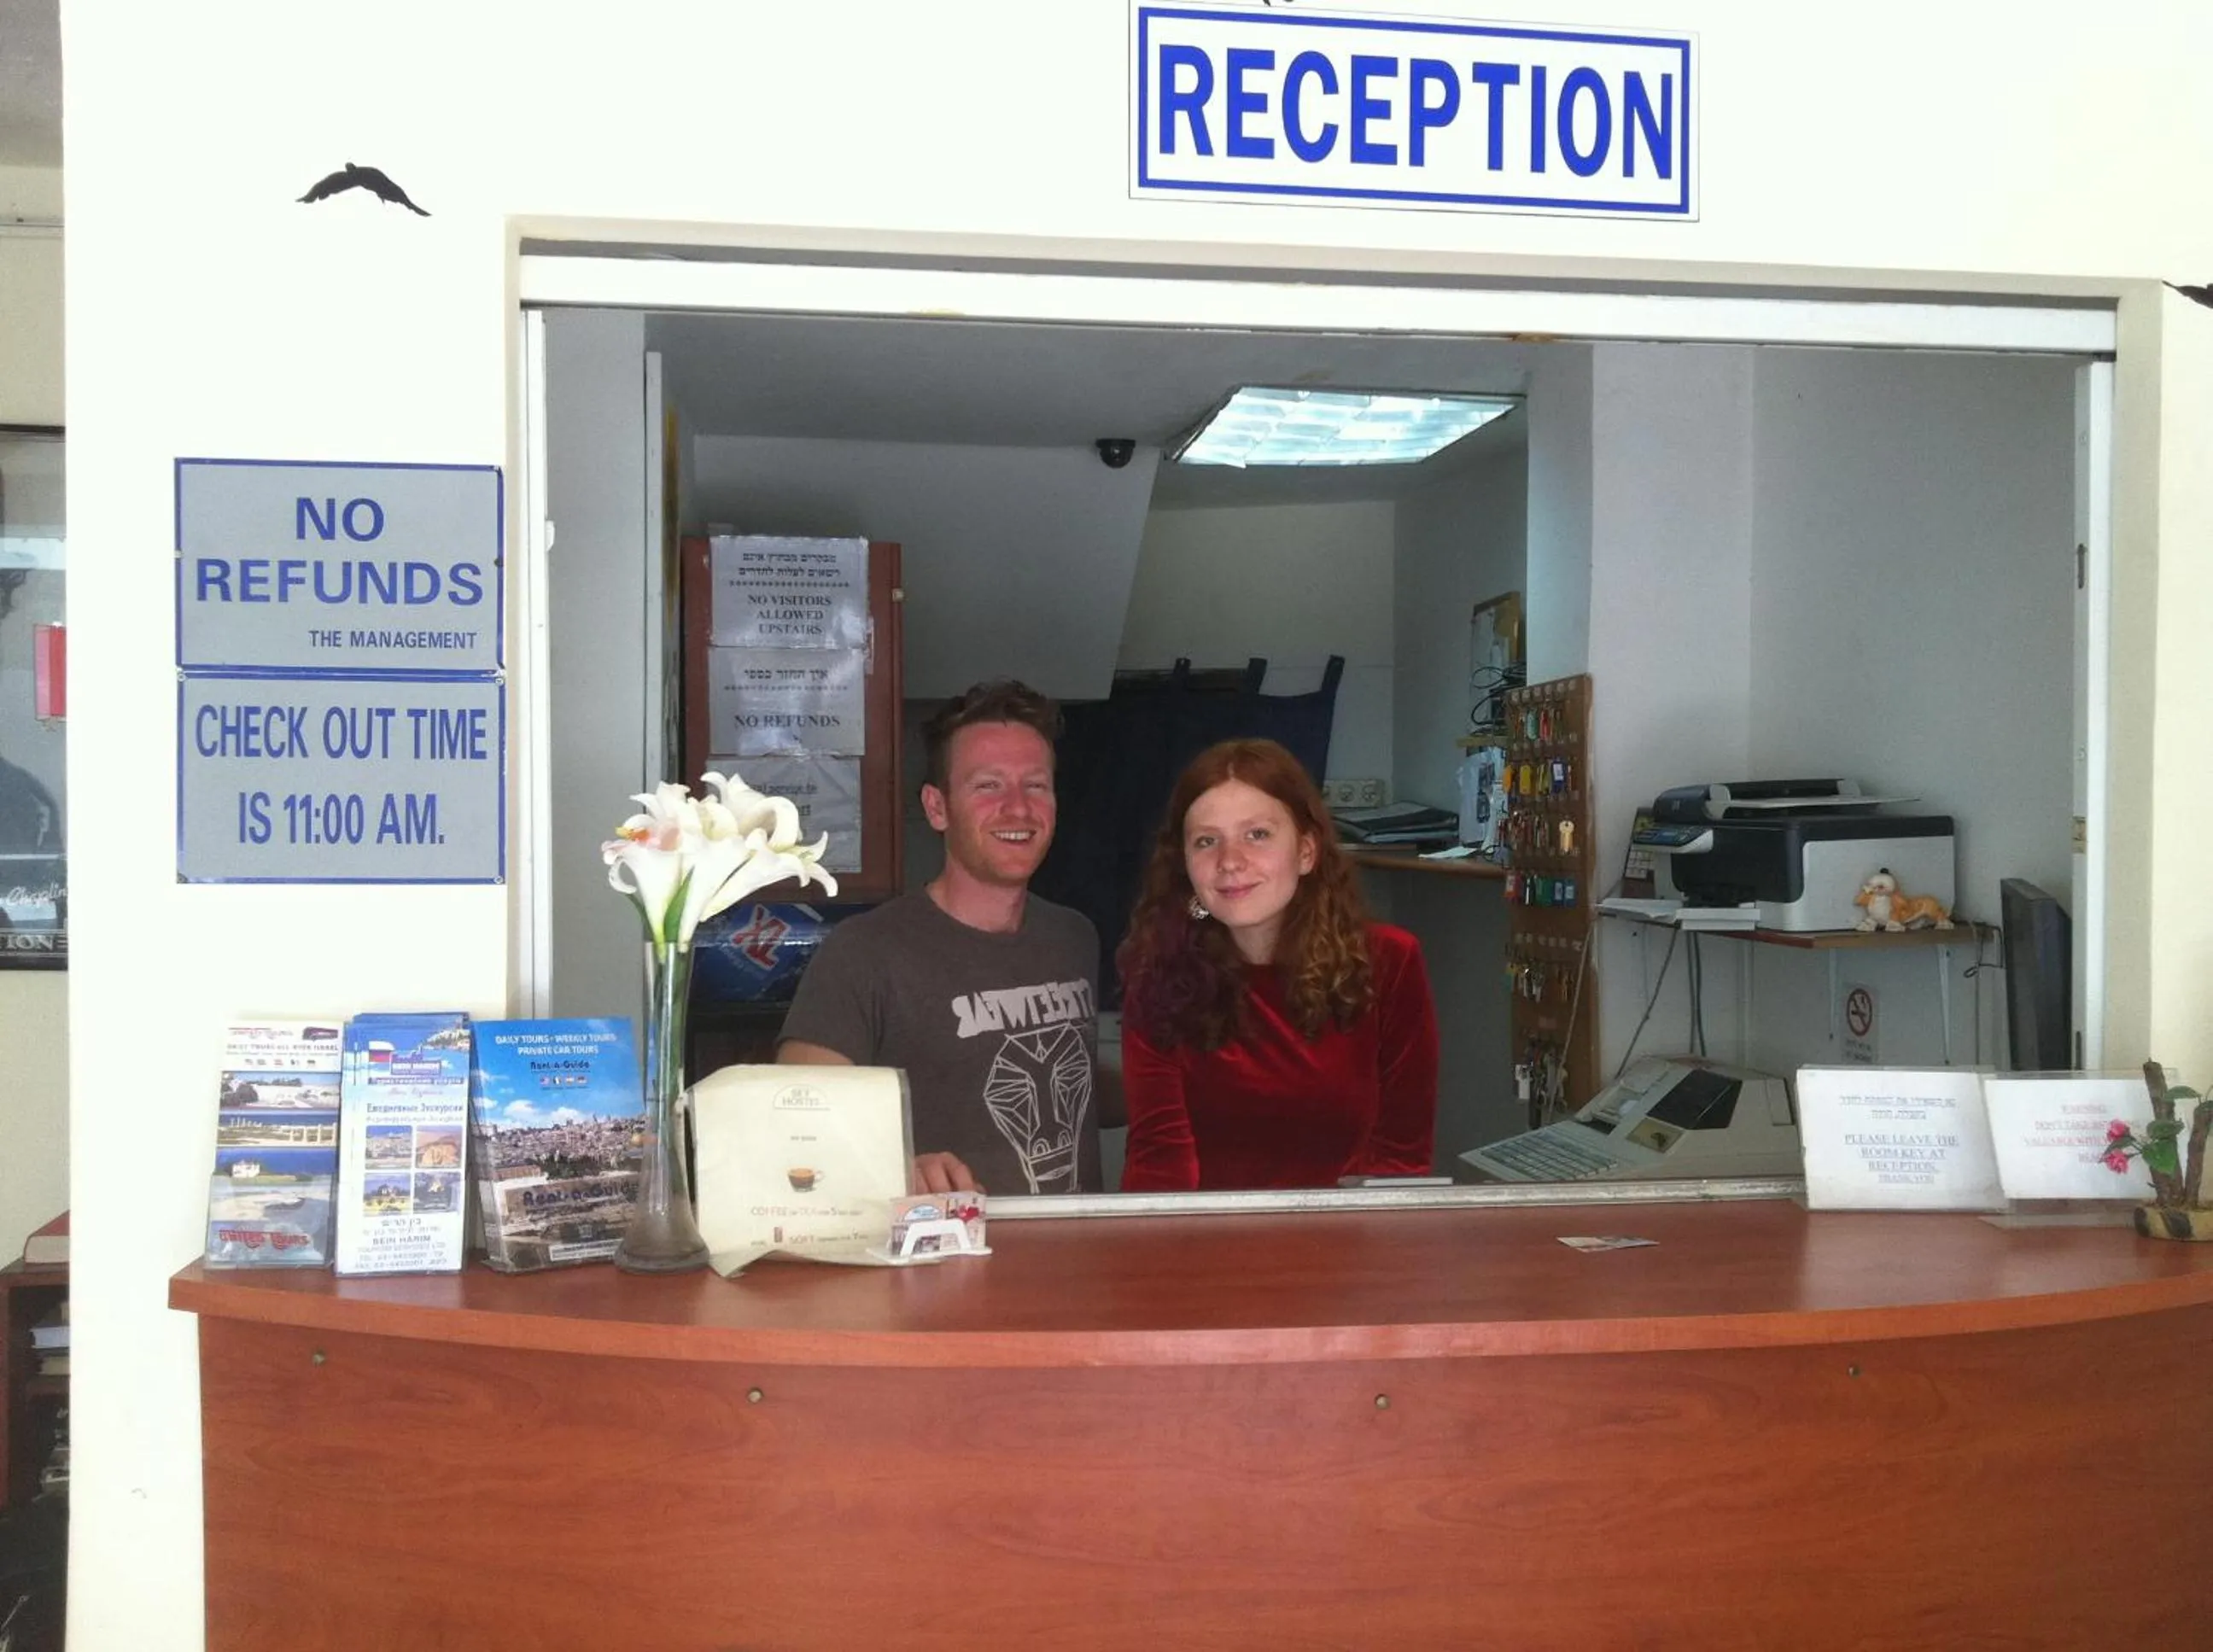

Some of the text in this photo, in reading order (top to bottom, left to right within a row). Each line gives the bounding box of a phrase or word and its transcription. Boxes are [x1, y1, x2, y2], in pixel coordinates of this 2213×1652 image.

[1159, 44, 1673, 180] RECEPTION
[295, 497, 385, 542] NO
[196, 557, 483, 606] REFUNDS
[747, 594, 832, 605] NO VISITORS
[756, 610, 824, 619] ALLOWED
[759, 624, 823, 635] UPSTAIRS
[308, 630, 478, 650] THE MANAGEMENT
[734, 715, 841, 727] NO REFUNDS
[195, 704, 488, 760] CHECK OUT TIME
[238, 791, 445, 845] IS 11:00 AM.
[494, 1035, 519, 1045] DAILY
[522, 1034, 549, 1044] TOURS
[517, 1046, 552, 1056] PRIVATE
[573, 1045, 599, 1055] TOURS
[1844, 1134, 1890, 1146] PLEASE
[1893, 1134, 1931, 1146] LEAVE
[1930, 1148, 1947, 1159] AT
[750, 1205, 788, 1217] COFFEE
